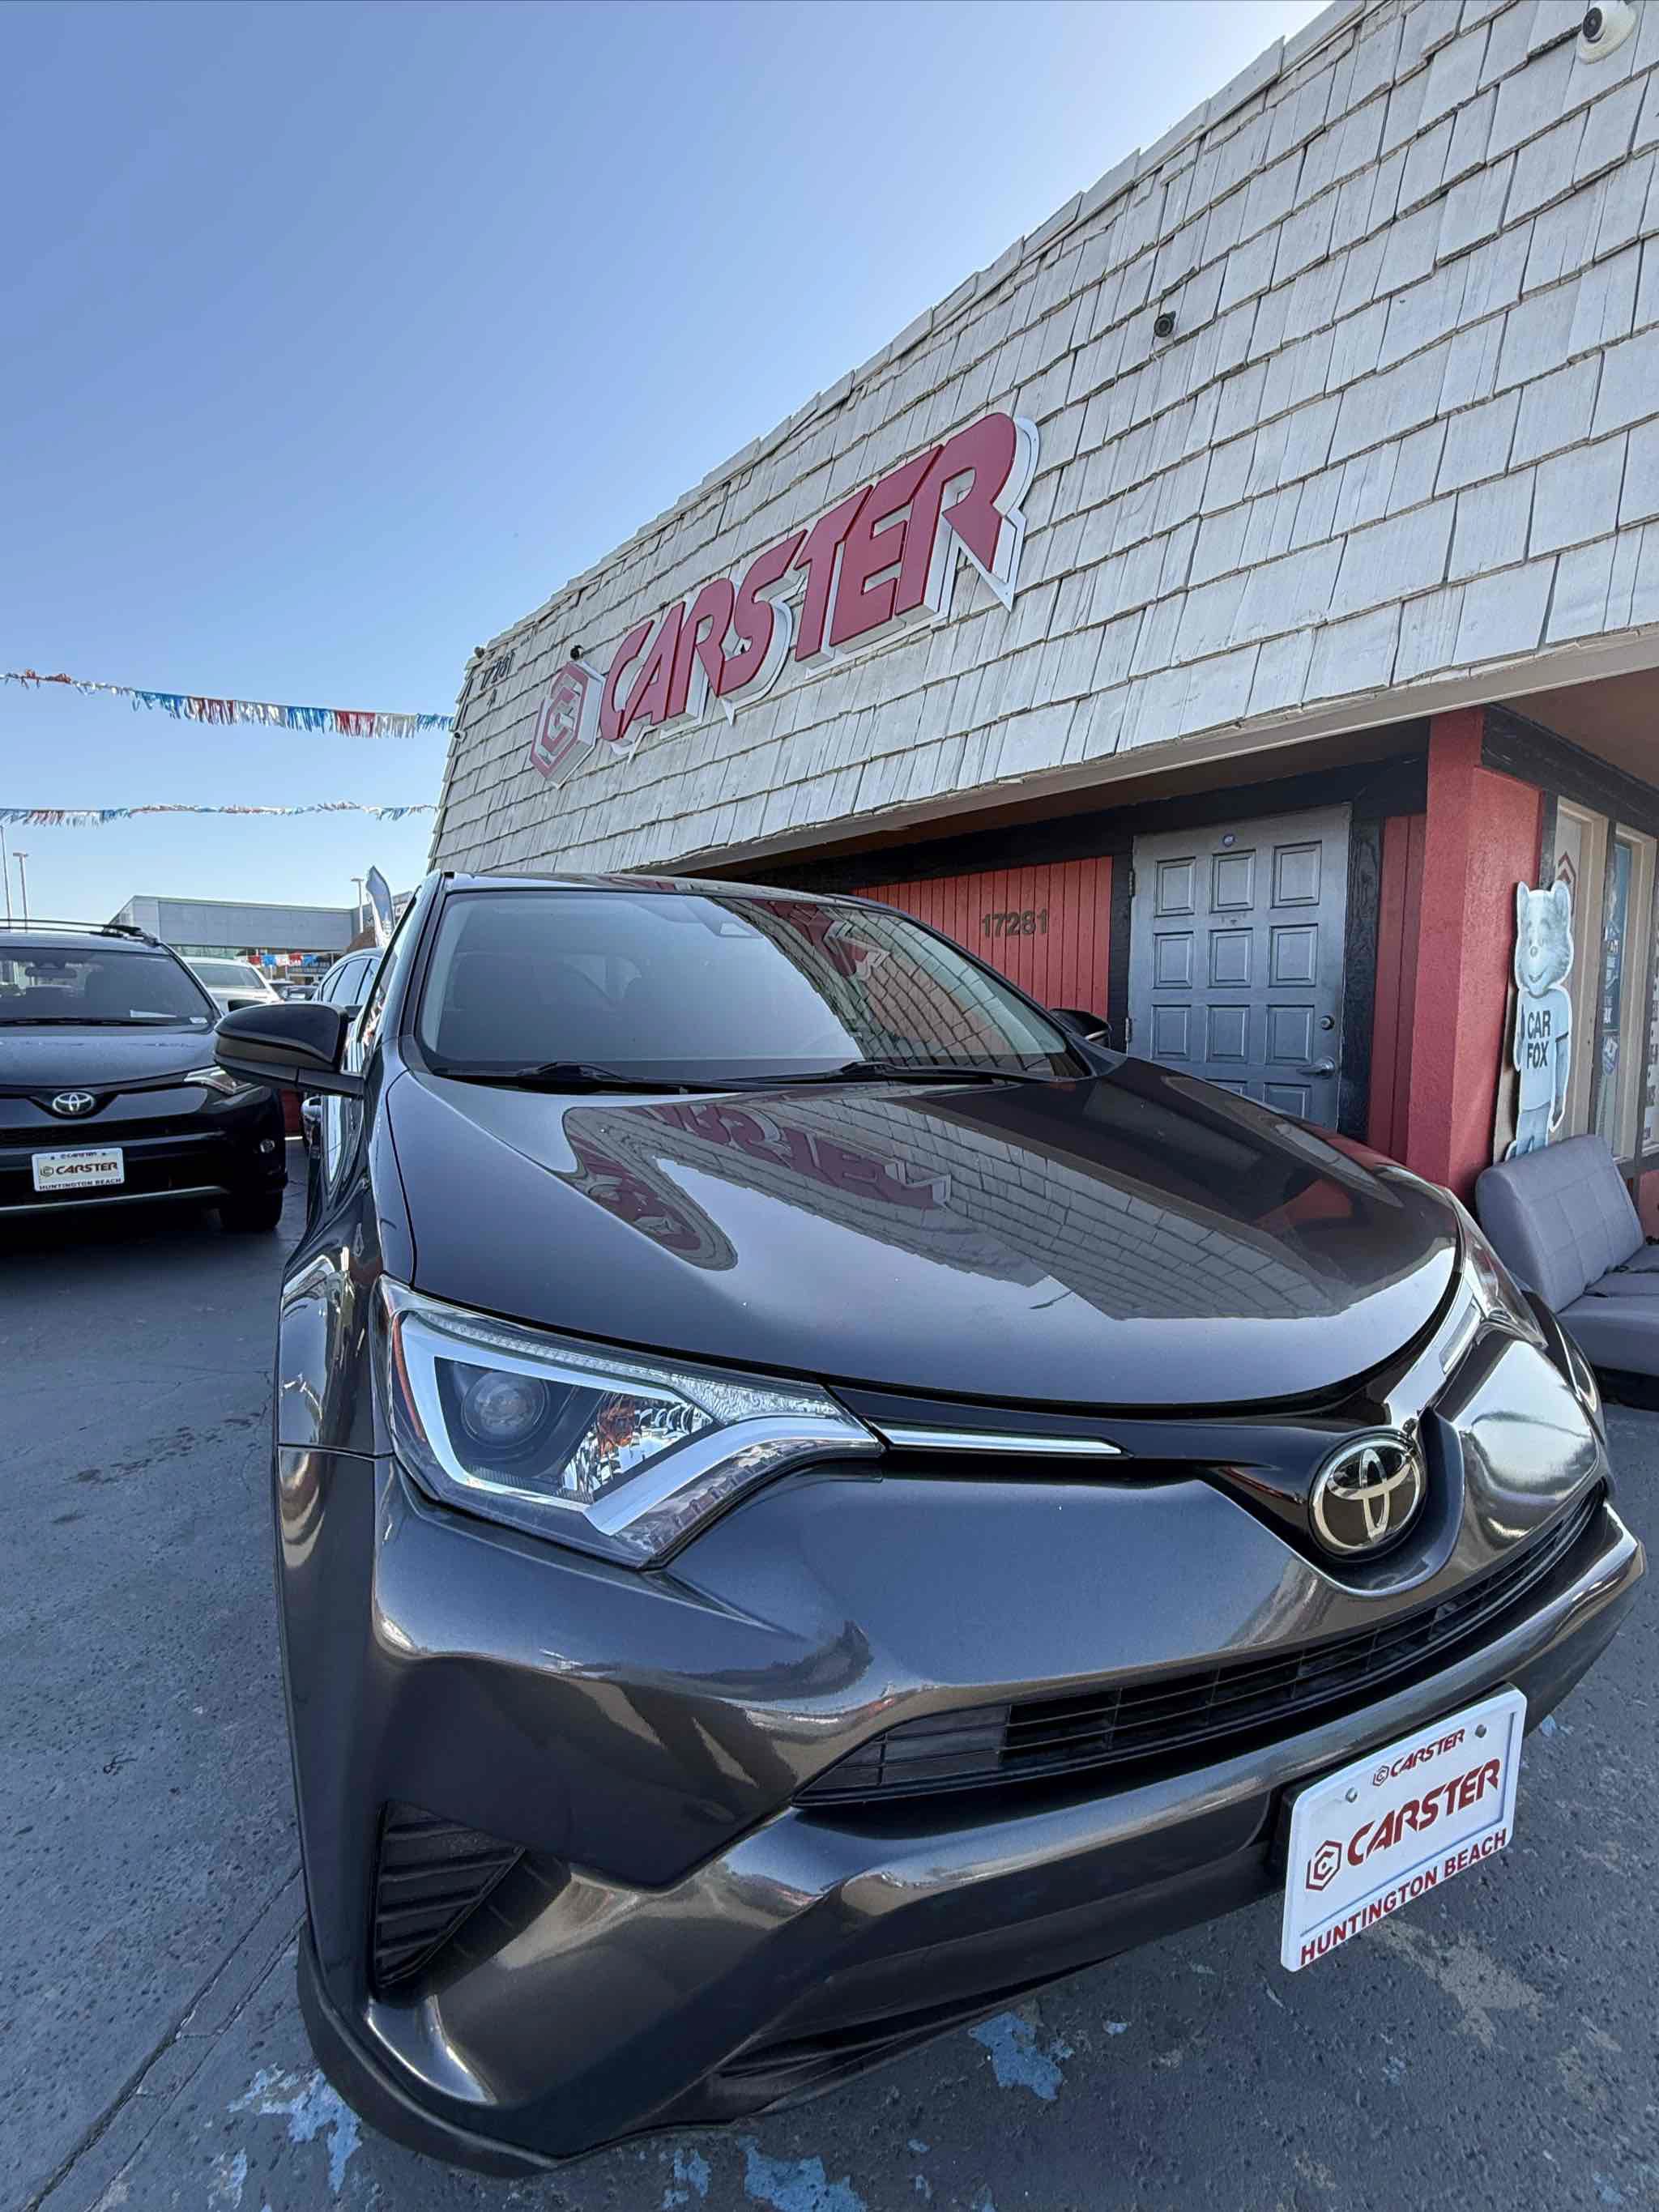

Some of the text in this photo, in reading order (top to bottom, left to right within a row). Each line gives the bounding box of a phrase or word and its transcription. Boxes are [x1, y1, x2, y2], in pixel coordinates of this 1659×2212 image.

[599, 411, 1022, 743] CARSTER
[982, 908, 1047, 938] 17281
[1528, 1010, 1551, 1039] CAR
[1527, 1041, 1550, 1069] FOX
[56, 1161, 117, 1174] CARSTER
[39, 1178, 122, 1190] HUNTINGTON BEACH
[1390, 1728, 1465, 1778] CARSTER
[1347, 1758, 1500, 1866] CARSTER
[1299, 1827, 1508, 1967] HUNTINGTON BEACH
